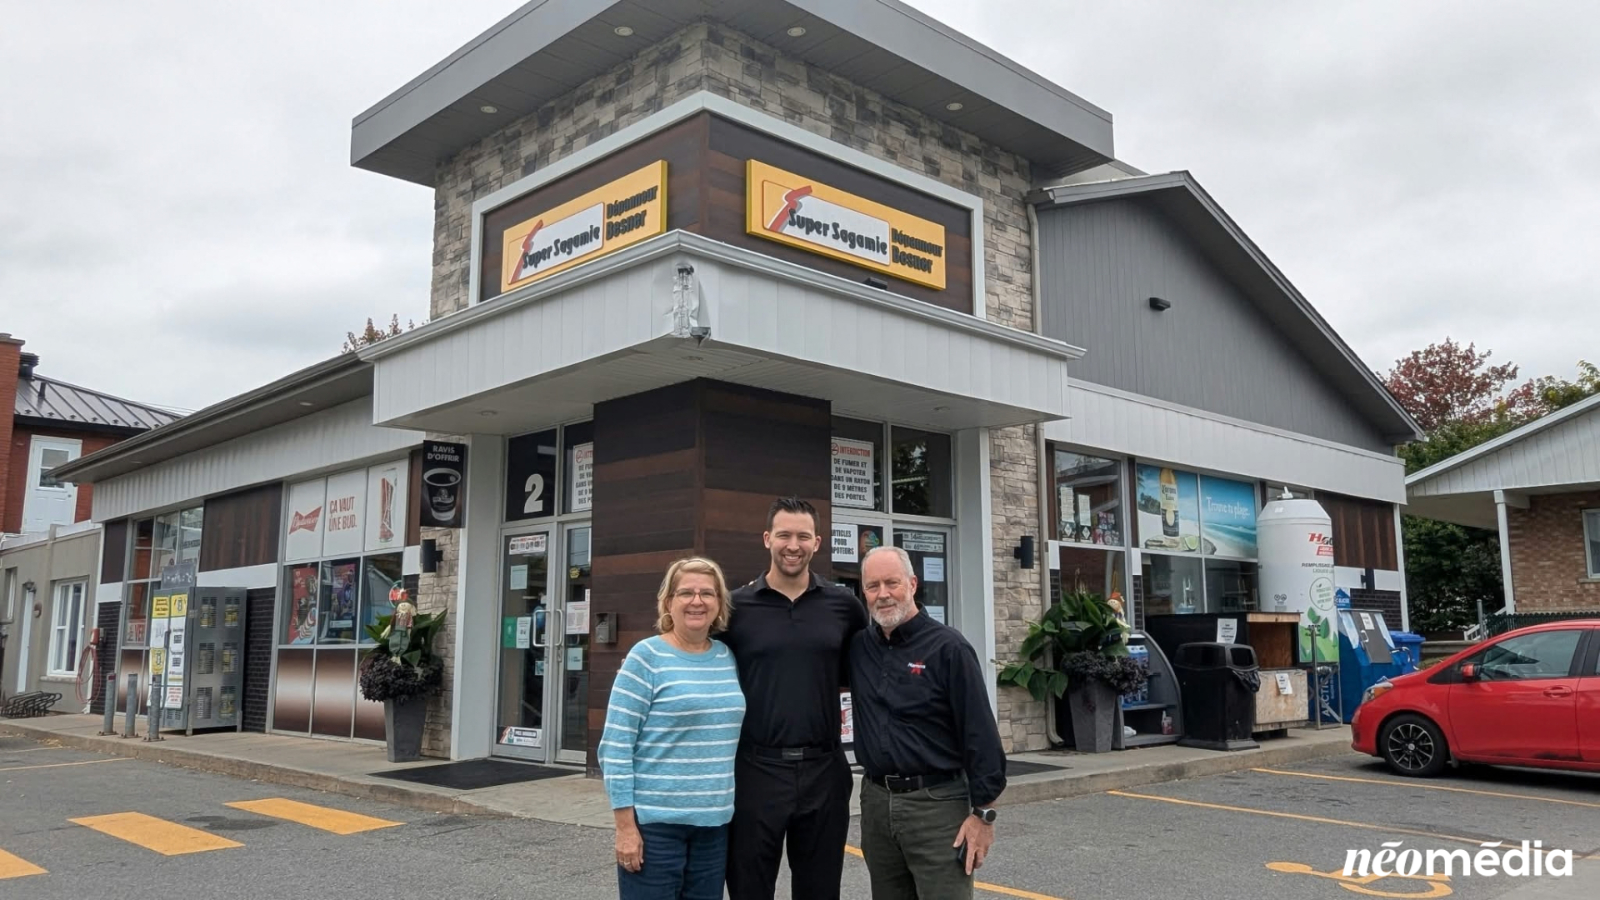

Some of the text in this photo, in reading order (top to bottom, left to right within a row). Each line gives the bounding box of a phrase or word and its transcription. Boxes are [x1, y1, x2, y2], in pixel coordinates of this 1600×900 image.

[606, 185, 658, 220] Dépanneur
[605, 210, 647, 241] Besner
[788, 208, 888, 256] Super Sagamie
[521, 224, 601, 269] Super Sagamie
[891, 227, 944, 258] Dépanneur
[891, 245, 934, 274] Besner
[427, 453, 461, 463] D'OFFRIR
[432, 445, 456, 454] RAVIS
[840, 446, 870, 457] INTERDICTION
[835, 466, 866, 476] DE VAPOTER
[841, 459, 859, 467] FUMER
[523, 472, 545, 514] 2
[834, 483, 841, 491] DE
[338, 496, 355, 513] VAUT
[328, 514, 358, 532] UNE BUD.
[834, 537, 847, 546] POUR
